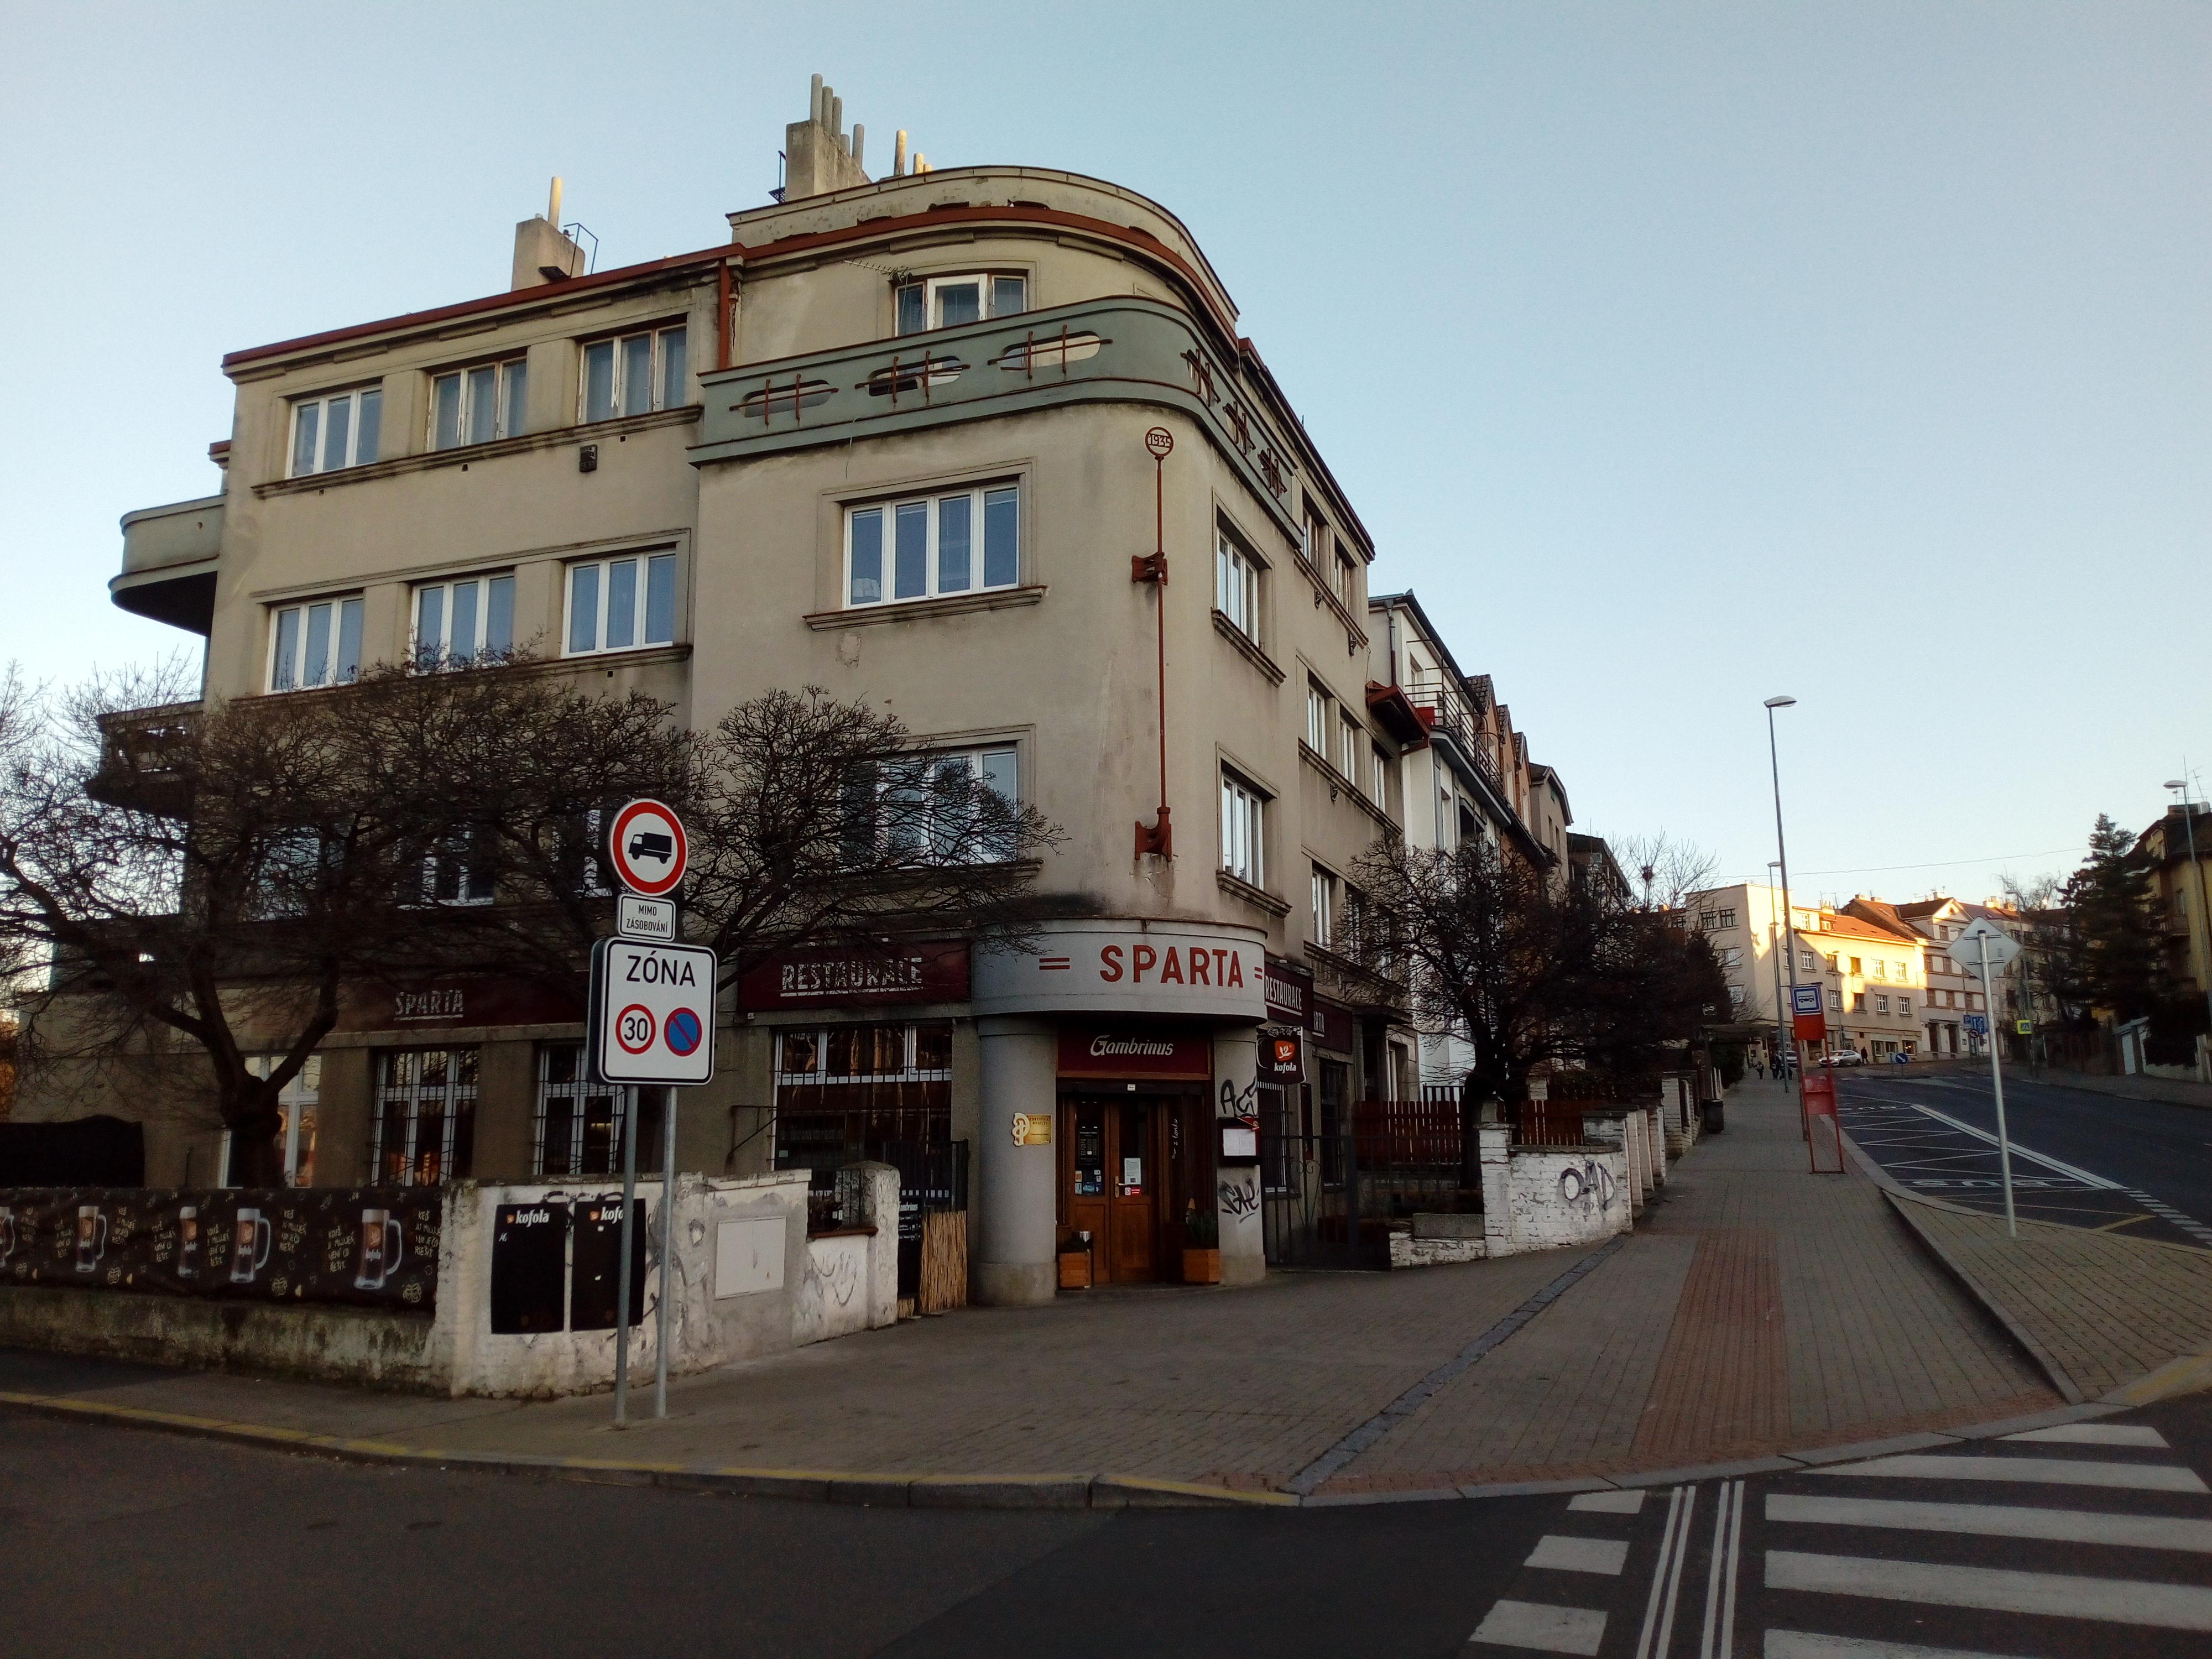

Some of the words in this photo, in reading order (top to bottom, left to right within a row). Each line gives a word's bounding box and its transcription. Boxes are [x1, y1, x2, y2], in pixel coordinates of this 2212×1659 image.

[1149, 434, 1170, 447] 1935
[638, 904, 658, 916] MIMO
[626, 917, 669, 933] ZÁSOBOVÁNÍ
[627, 950, 696, 988] ZÓNA
[782, 957, 922, 991] RESTAURACE
[1100, 945, 1244, 988] SPARTA
[395, 989, 464, 1015] SPARTA
[1265, 974, 1302, 1011] RESTAURACE
[625, 1018, 648, 1042] 30
[1313, 1010, 1325, 1032] RTA
[1090, 1034, 1174, 1056] Gambrinus
[1274, 1062, 1297, 1074] kofola
[515, 1208, 551, 1228] kofola
[601, 1206, 624, 1225] kofo
